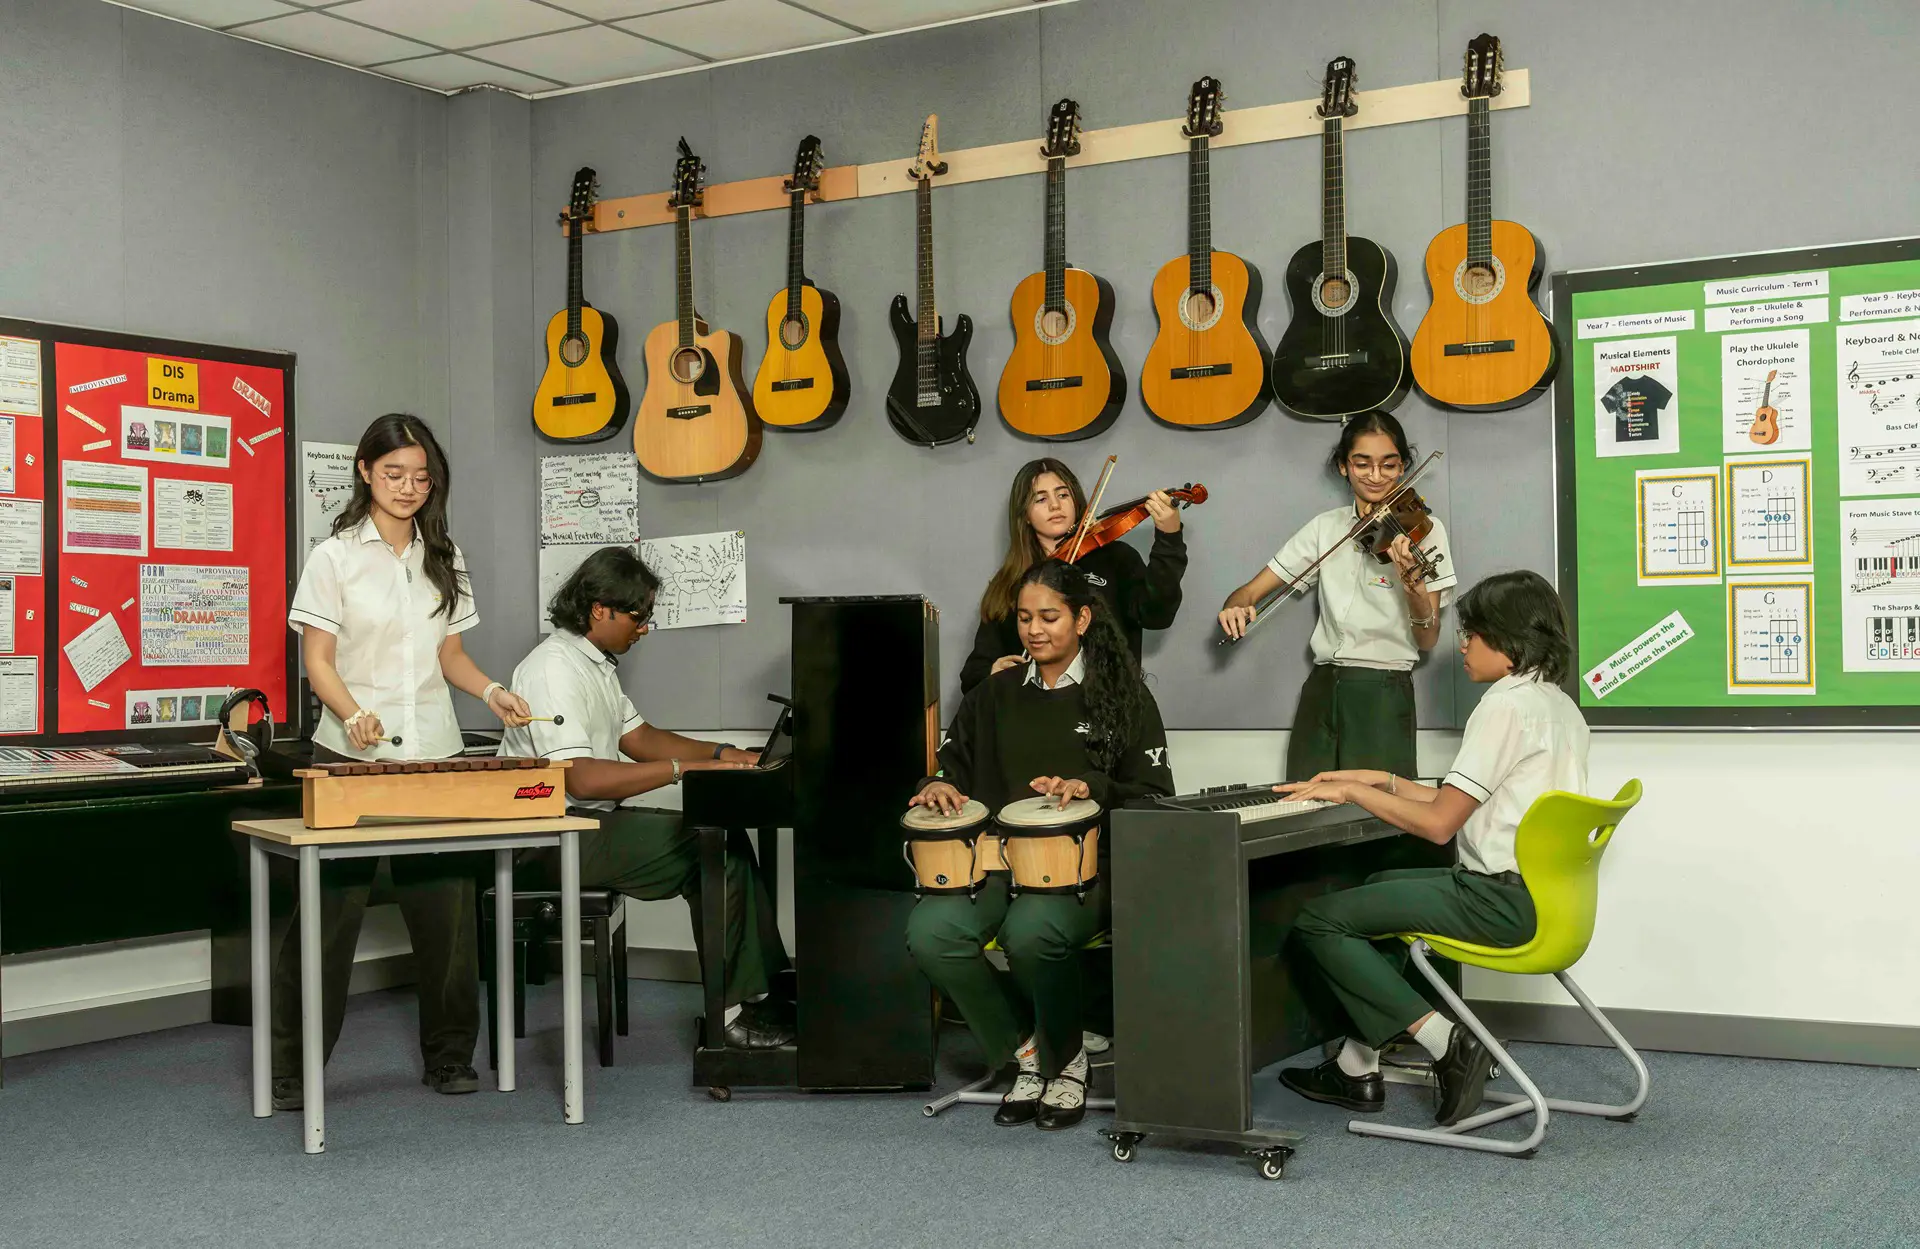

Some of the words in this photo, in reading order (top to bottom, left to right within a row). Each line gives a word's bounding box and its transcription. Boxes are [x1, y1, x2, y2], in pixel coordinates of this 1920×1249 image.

[1741, 283, 1785, 293] Curriculum
[1764, 302, 1794, 311] Ukulele
[1849, 308, 1902, 317] Performance
[1618, 317, 1652, 327] Elements
[1664, 315, 1687, 323] Music
[1730, 315, 1774, 326] Performing
[1784, 313, 1804, 323] Song
[1766, 342, 1798, 350] Ukulele
[1845, 334, 1894, 346] Keyboard
[1600, 351, 1630, 360] Musical
[1633, 349, 1670, 358] Elements
[1737, 356, 1795, 366] Chordophone
[163, 365, 184, 379] DIS
[1610, 362, 1660, 373] MADTSHIRT
[70, 375, 127, 393] IMPROVISATION
[153, 387, 194, 404] Drama
[234, 379, 272, 414] DRAMA
[307, 452, 334, 460] Keyboard
[1762, 470, 1773, 483] D
[553, 532, 573, 540] Musical
[574, 531, 604, 540] Features
[142, 565, 164, 576] FORM
[142, 584, 167, 594] PLOT
[1764, 592, 1775, 604] G
[70, 603, 99, 616] SCRIPT
[174, 610, 216, 624] DRAMA
[223, 634, 248, 643] GENRE
[1609, 650, 1633, 670] Music
[1633, 632, 1660, 655] powers
[1661, 622, 1675, 634] the
[1599, 676, 1619, 694] mind
[1627, 655, 1652, 674] moves
[1652, 645, 1667, 657] the
[1665, 629, 1688, 647] heart
